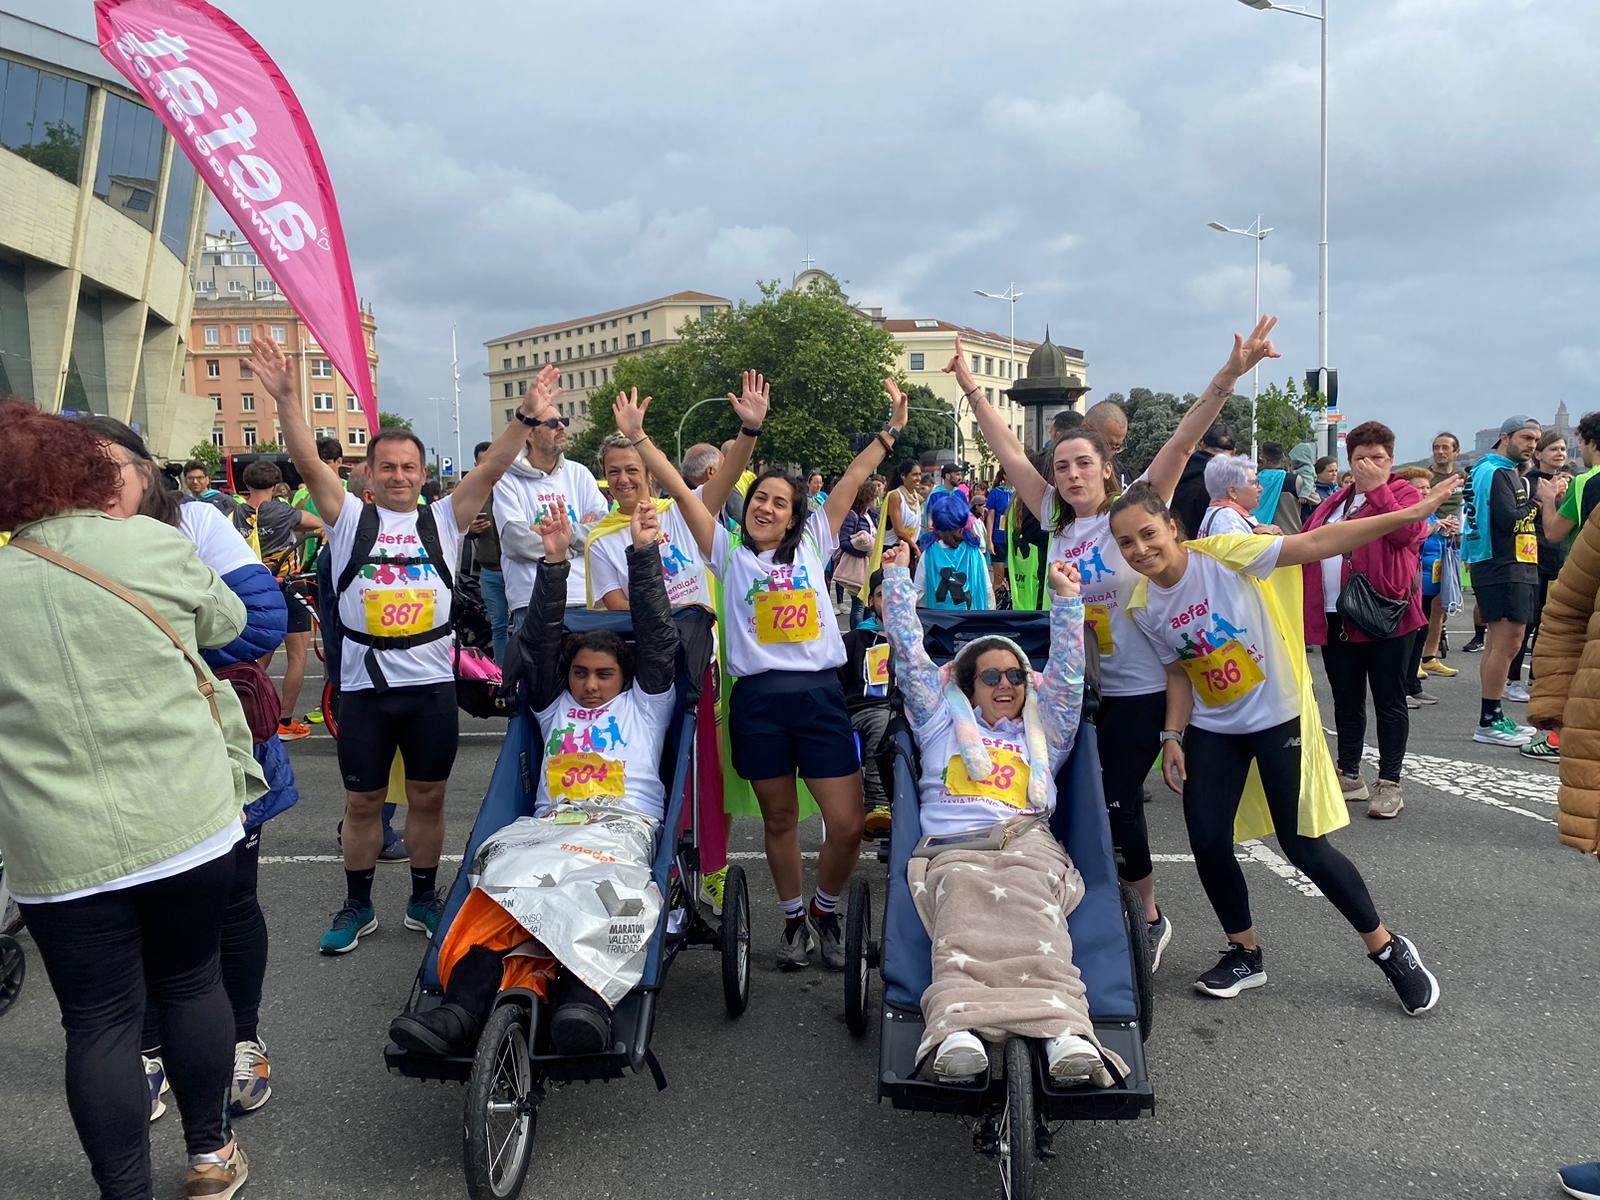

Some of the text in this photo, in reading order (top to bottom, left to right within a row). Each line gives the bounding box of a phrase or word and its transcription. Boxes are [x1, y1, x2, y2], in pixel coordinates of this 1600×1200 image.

[442, 457, 452, 471] P
[378, 533, 418, 545] aefat
[380, 602, 424, 627] 367
[771, 604, 809, 630] 726
[1200, 658, 1242, 693] 736
[981, 737, 1023, 754] efat
[609, 922, 645, 935] MARATÓN
[608, 934, 643, 945] VALENCIA
